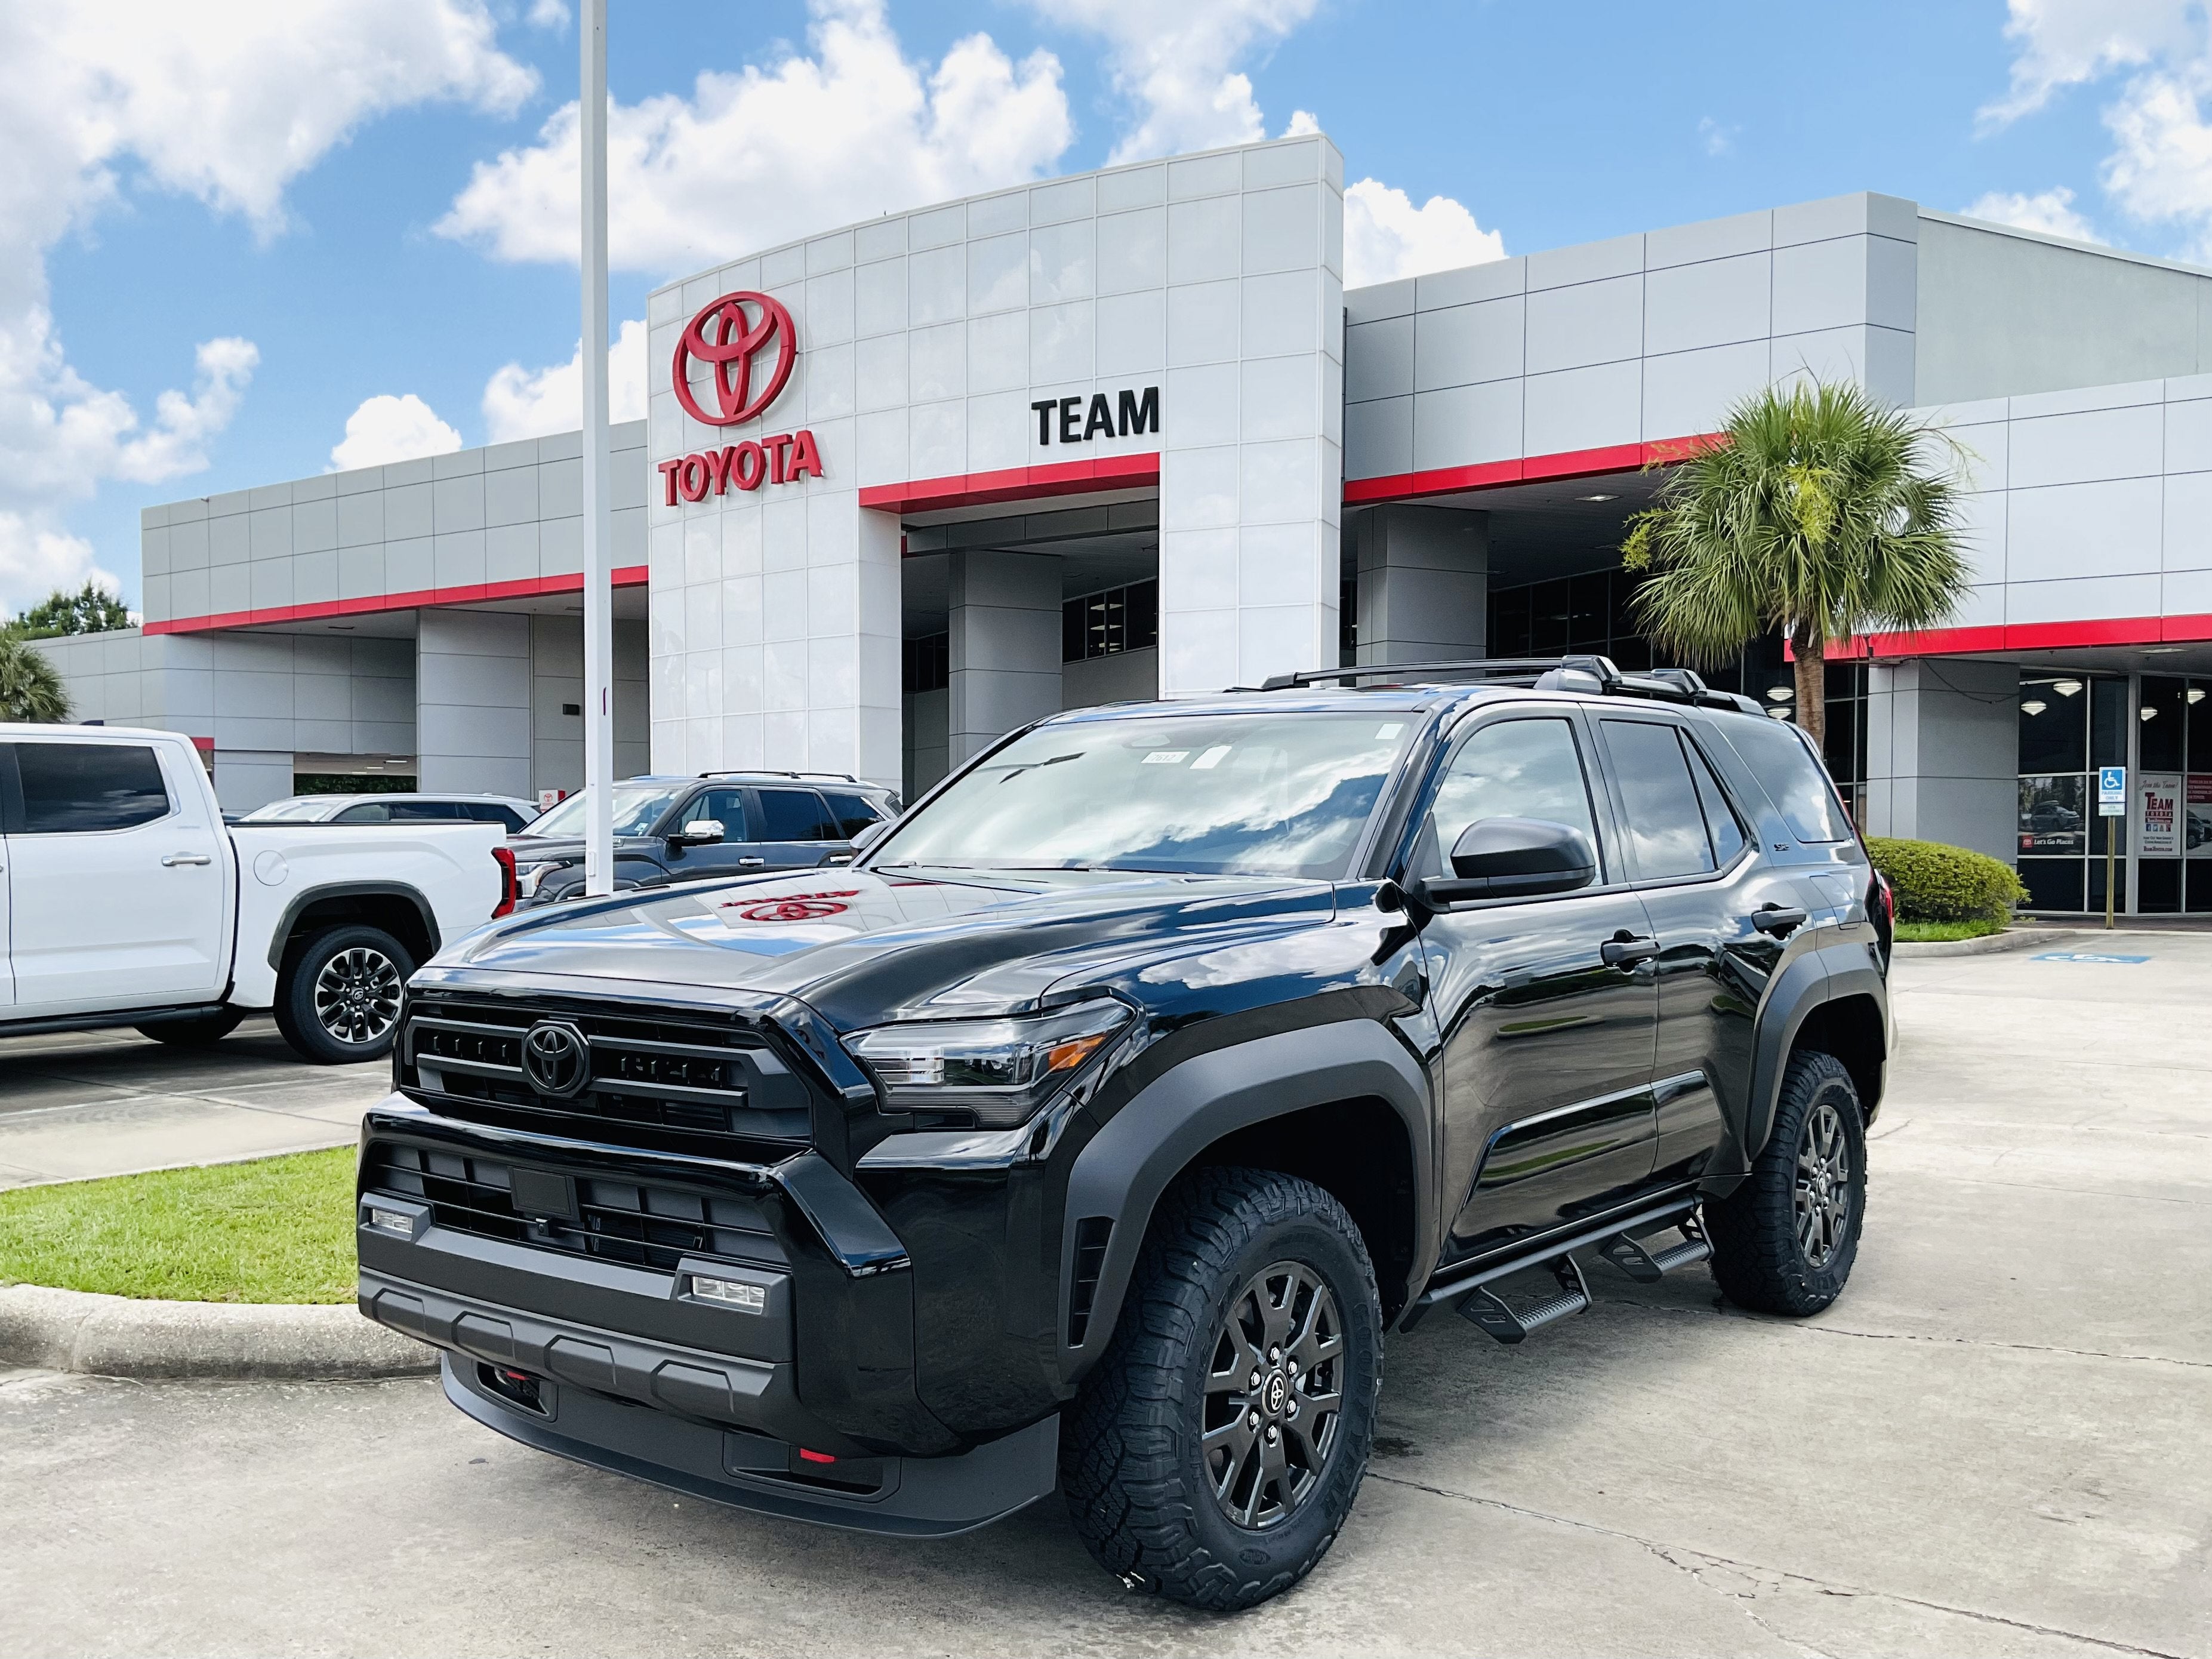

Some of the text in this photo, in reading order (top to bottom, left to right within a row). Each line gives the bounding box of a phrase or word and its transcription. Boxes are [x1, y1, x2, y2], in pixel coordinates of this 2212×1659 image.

[1031, 386, 1159, 445] TEAM
[658, 429, 824, 506] TOYOTA
[2145, 792, 2174, 810] TEAM
